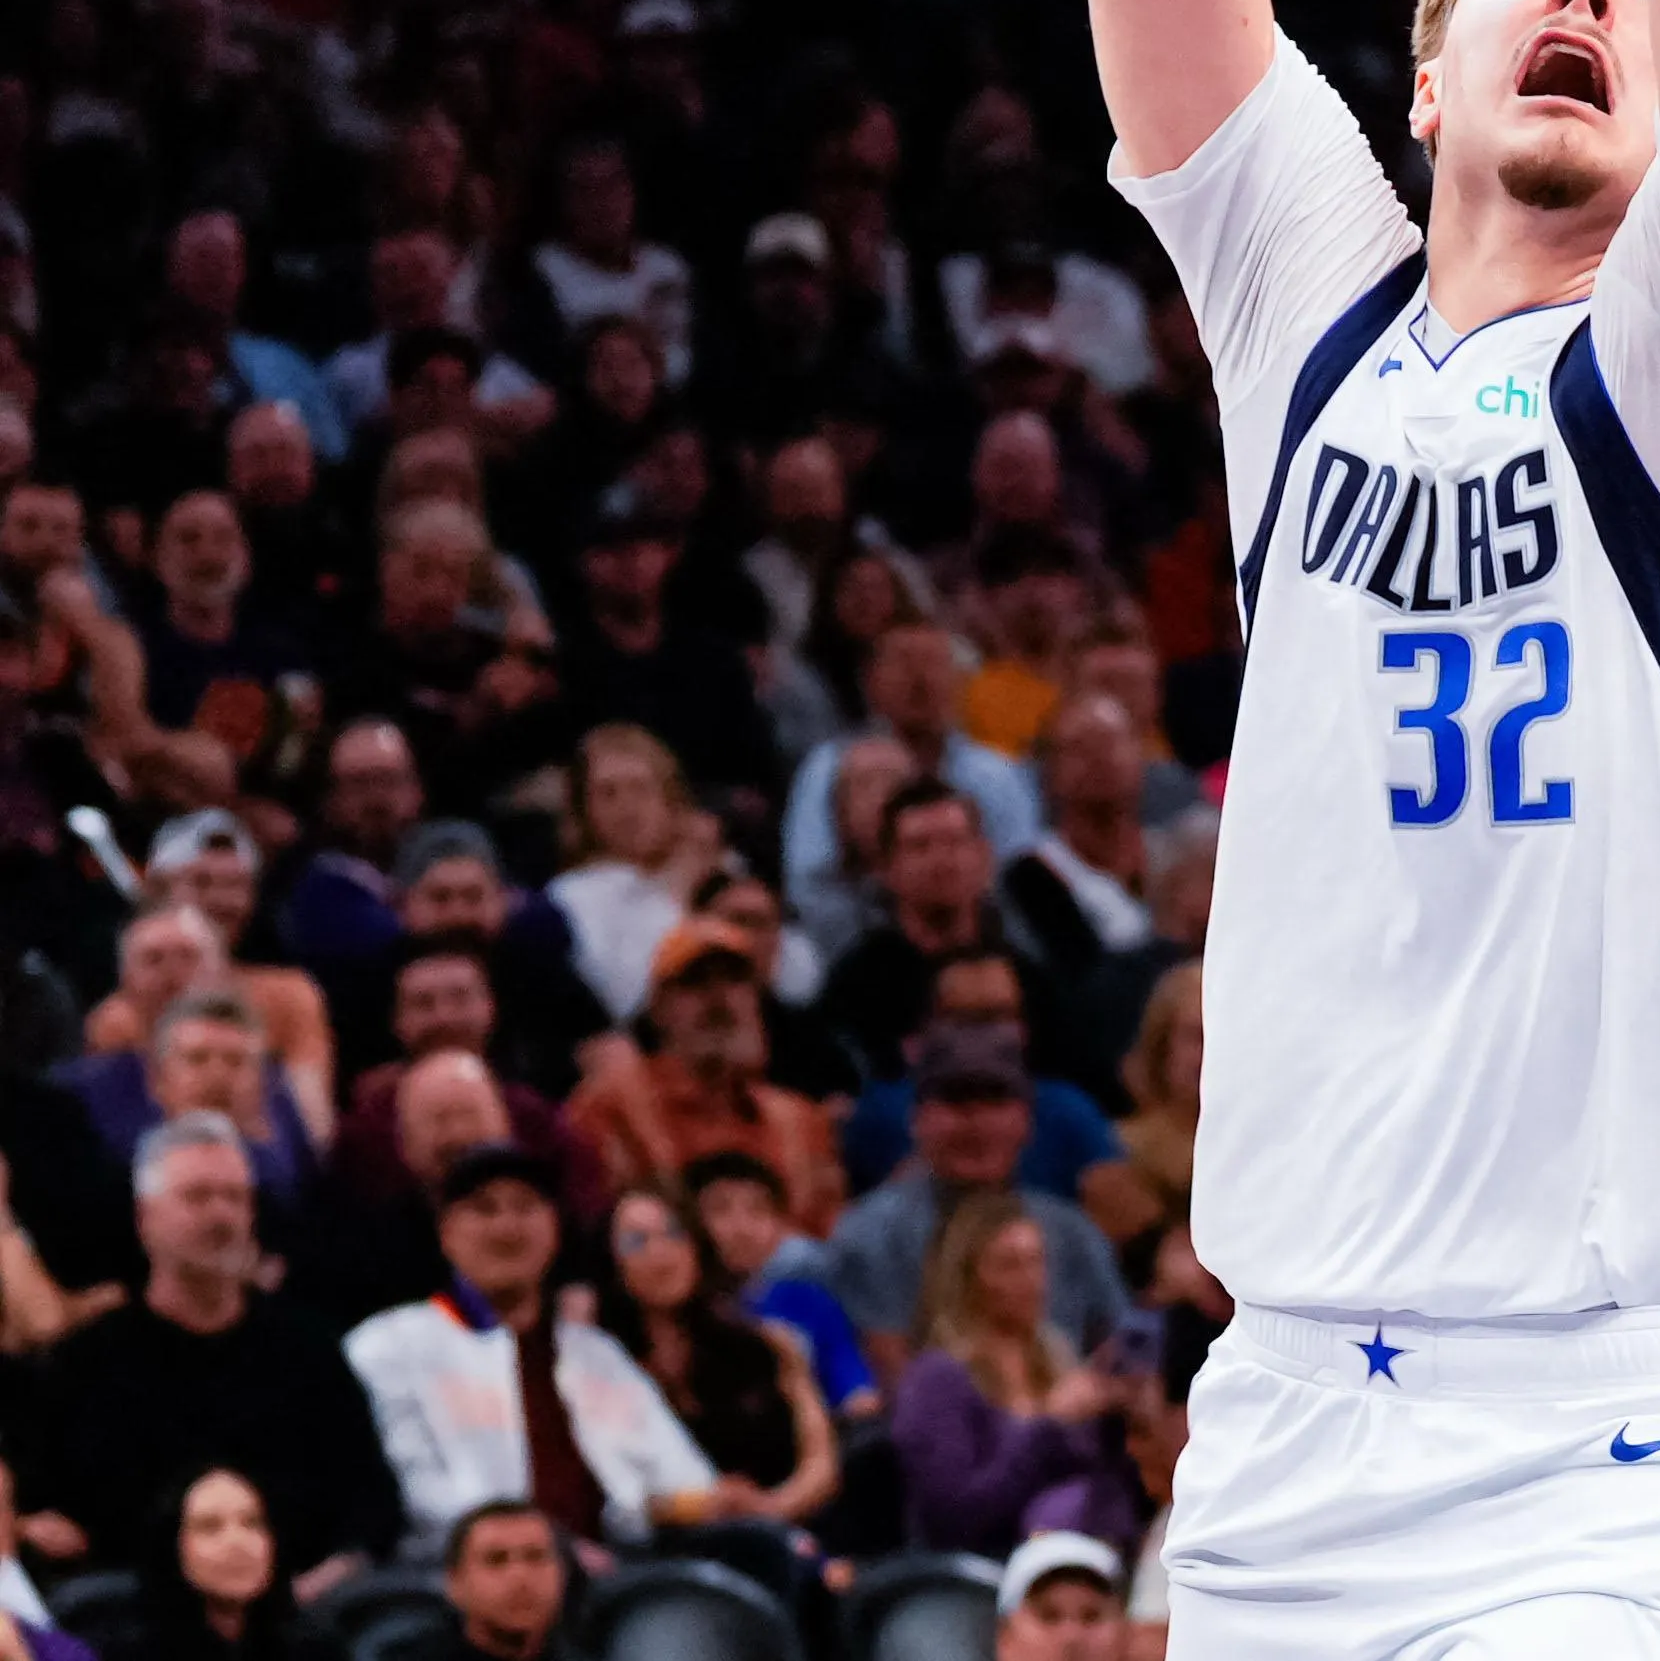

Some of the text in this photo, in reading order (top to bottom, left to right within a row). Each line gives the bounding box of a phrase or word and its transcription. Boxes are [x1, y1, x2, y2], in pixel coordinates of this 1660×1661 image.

[1476, 375, 1540, 418] chi
[1300, 442, 1563, 614] DALLAS
[1377, 619, 1576, 830] 32
